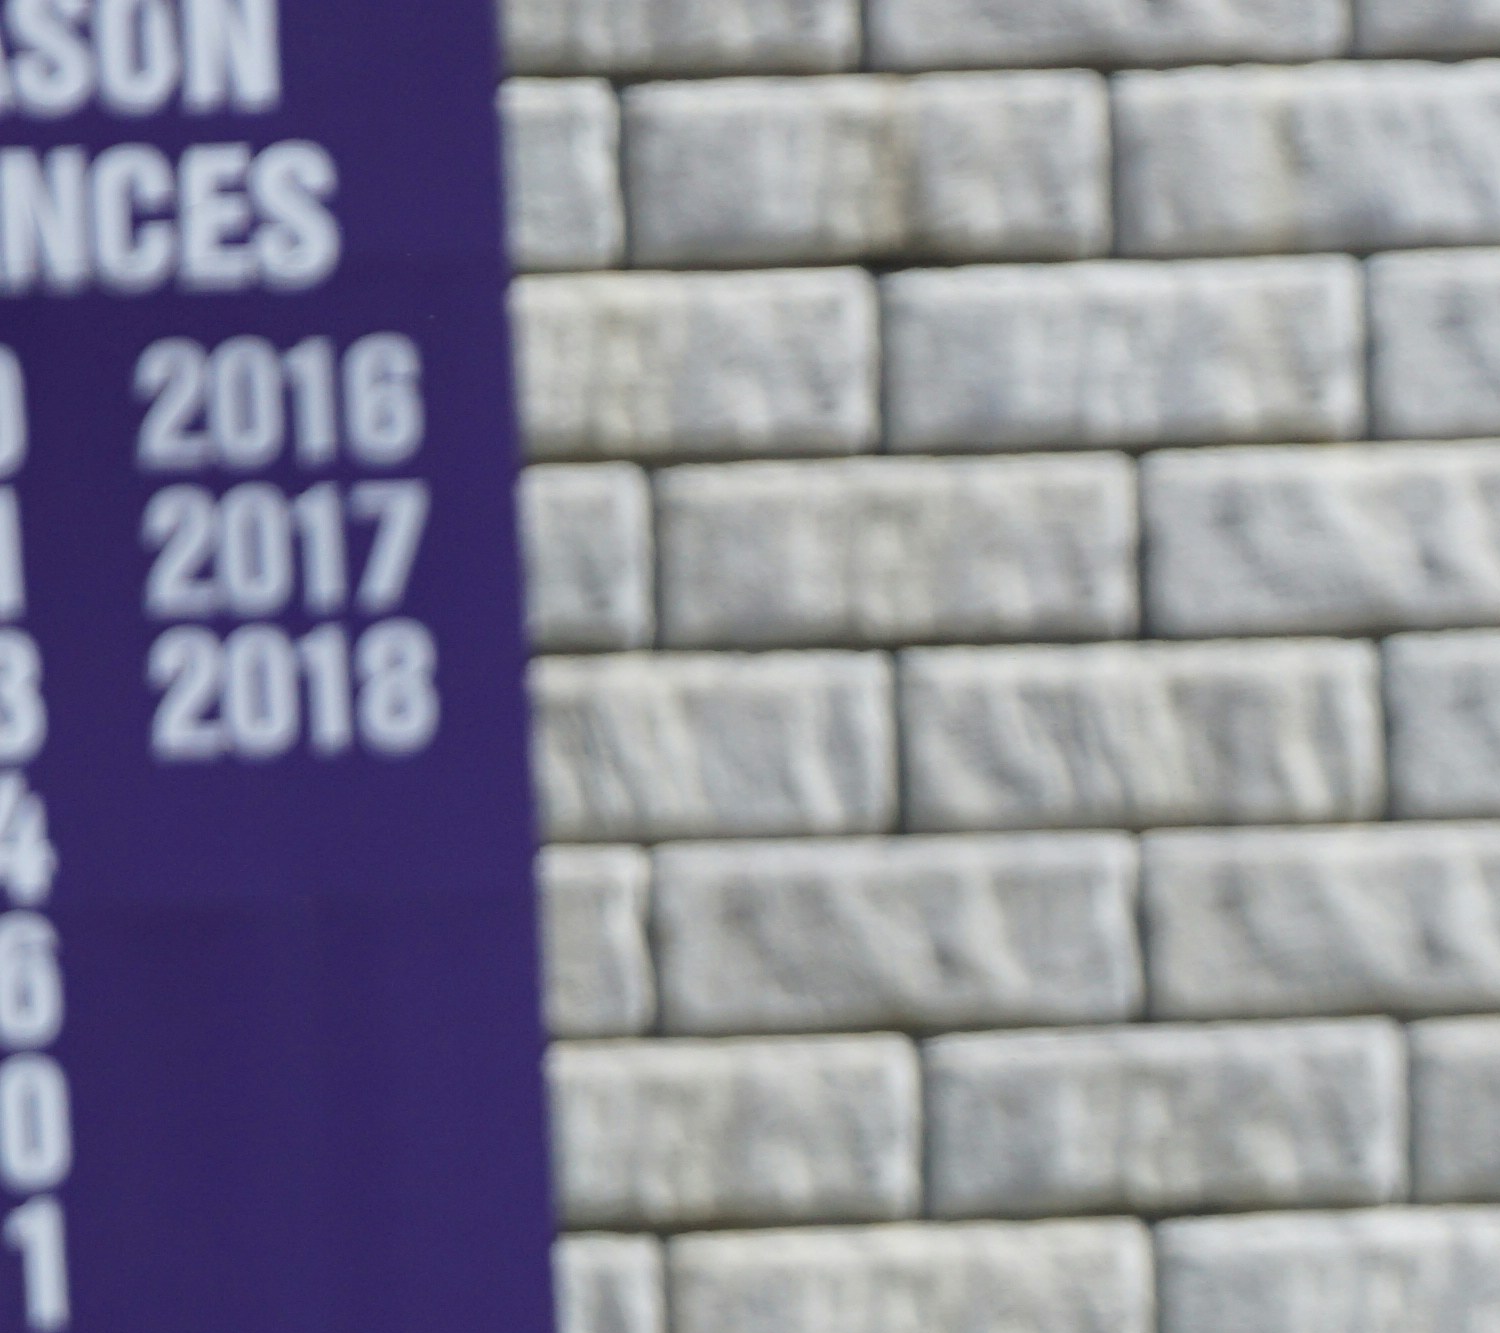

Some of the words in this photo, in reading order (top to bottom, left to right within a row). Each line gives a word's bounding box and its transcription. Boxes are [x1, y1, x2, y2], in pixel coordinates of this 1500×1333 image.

[0, 0, 281, 114] SON
[136, 334, 422, 466] 2016
[145, 482, 426, 613] 2017
[149, 621, 437, 755] 2018
